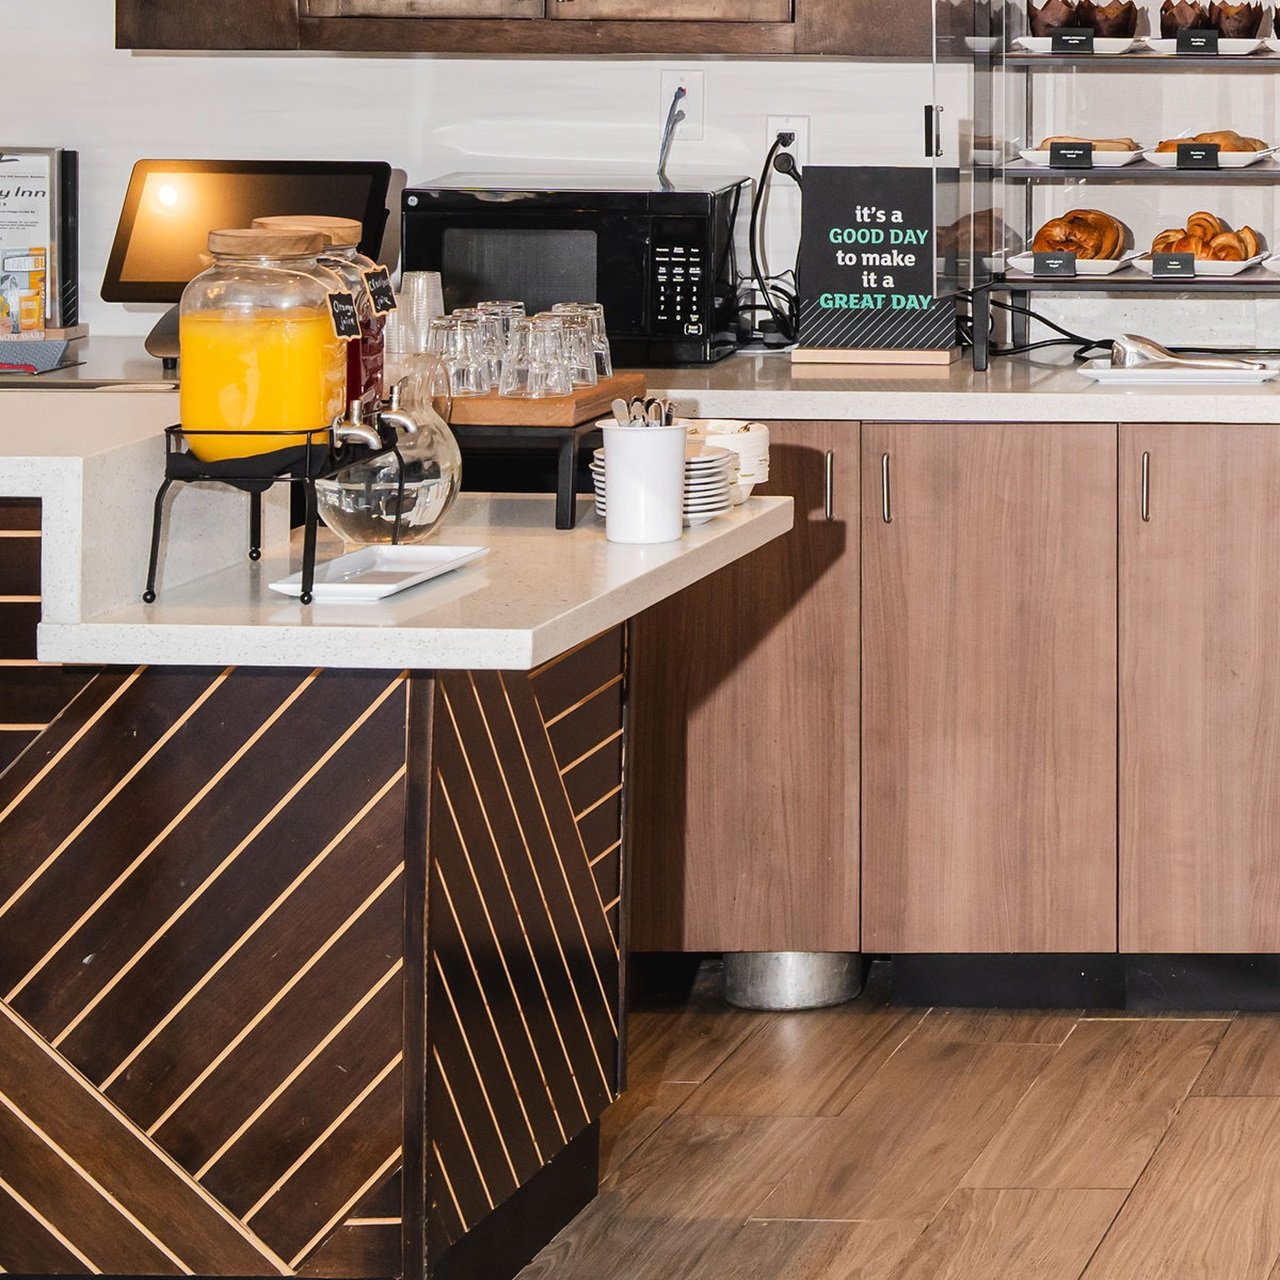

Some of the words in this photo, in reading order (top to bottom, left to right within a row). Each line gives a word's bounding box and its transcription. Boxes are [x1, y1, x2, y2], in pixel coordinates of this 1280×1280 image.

[15, 186, 46, 197] Inn
[855, 205, 886, 223] it’s
[890, 210, 904, 223] a
[829, 228, 885, 244] GOOD
[889, 228, 929, 245] DAY
[836, 250, 857, 266] to
[860, 250, 916, 267] make
[861, 271, 878, 288] it
[882, 275, 895, 288] a
[819, 293, 886, 310] GREAT
[891, 294, 937, 310] DAY.
